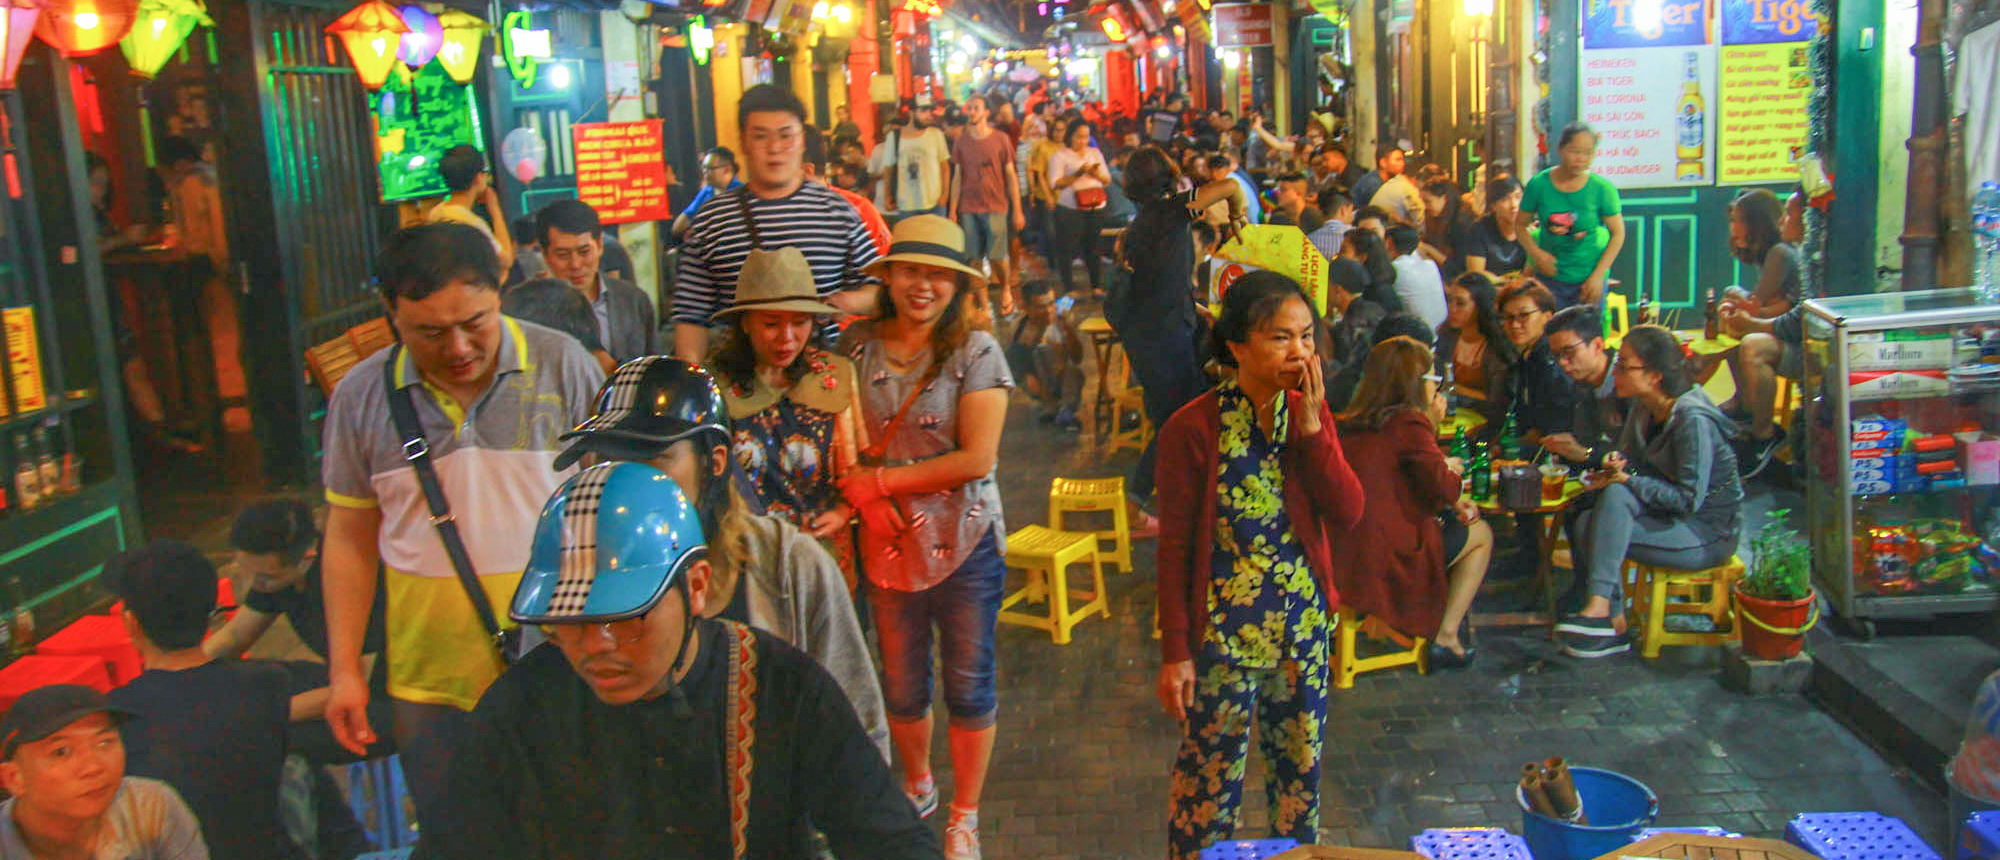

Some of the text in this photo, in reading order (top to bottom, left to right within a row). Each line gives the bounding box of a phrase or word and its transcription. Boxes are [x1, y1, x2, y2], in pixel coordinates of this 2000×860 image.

[1608, 0, 1700, 39] Ter
[1747, 0, 1819, 35] Tige
[1587, 58, 1635, 68] HEINEKEN
[1587, 76, 1633, 87] BIA TIGER
[1606, 93, 1646, 104] CORONA
